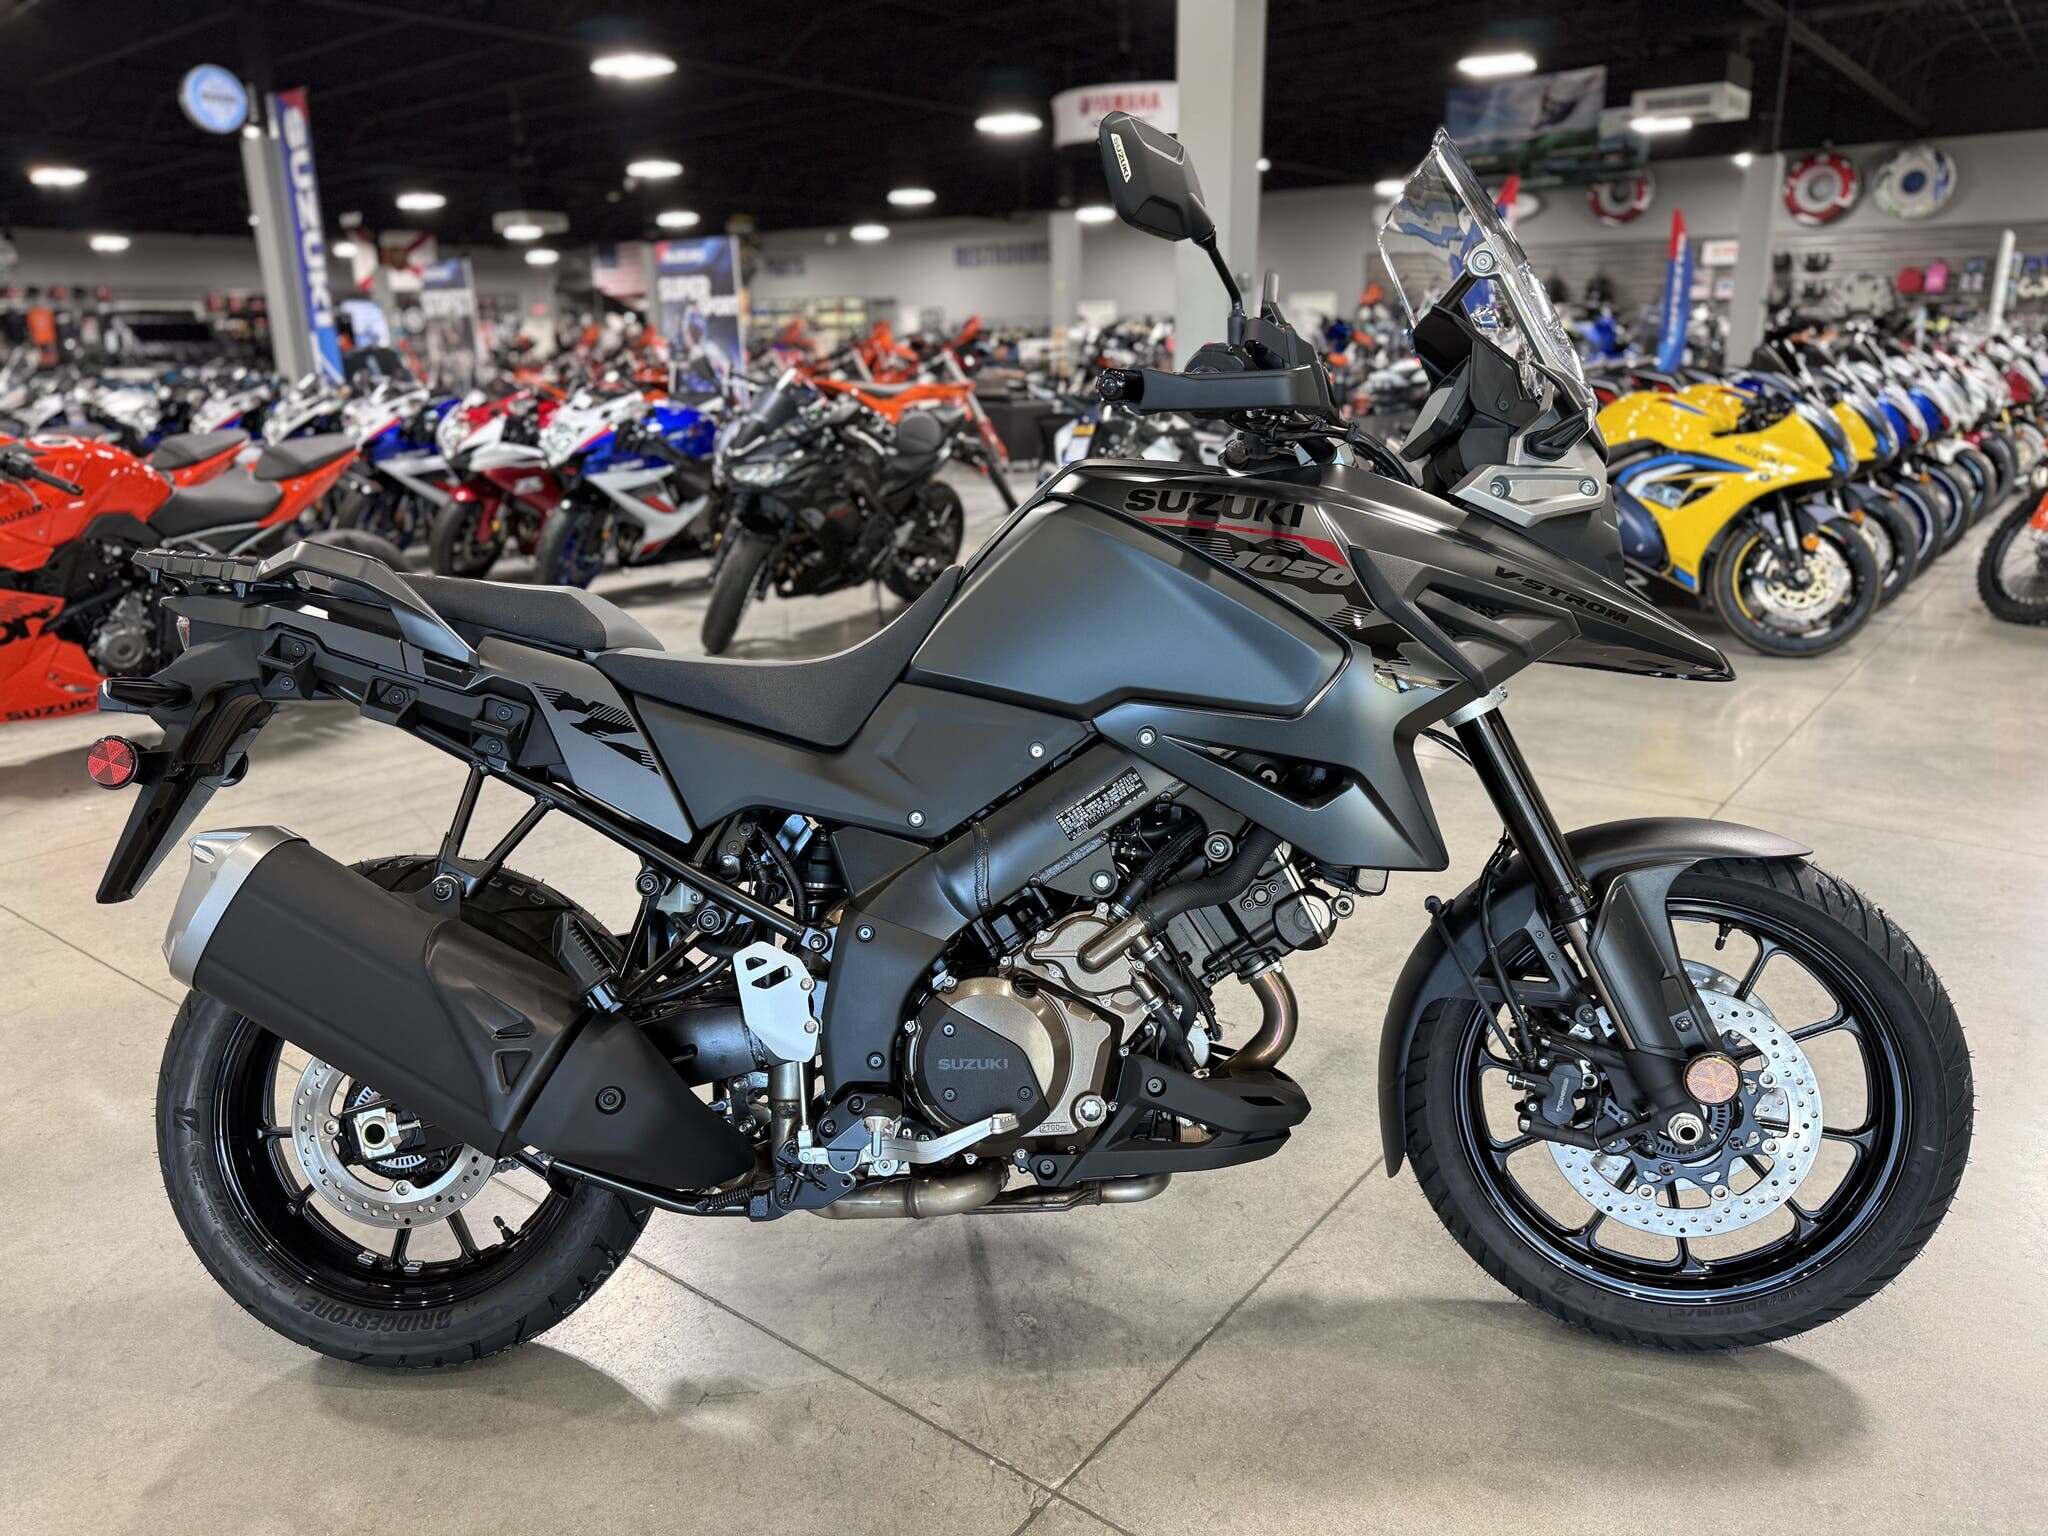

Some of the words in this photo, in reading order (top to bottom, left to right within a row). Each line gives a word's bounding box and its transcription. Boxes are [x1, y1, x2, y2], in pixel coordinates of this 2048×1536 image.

[1113, 136, 1130, 178] SUZUKI
[1124, 488, 1305, 528] SUZUKI
[1230, 550, 1357, 587] 1050
[1494, 565, 1631, 625] V-STROM
[937, 1058, 1009, 1070] SUZUKI
[300, 1296, 453, 1332] BRIDGESTONE
